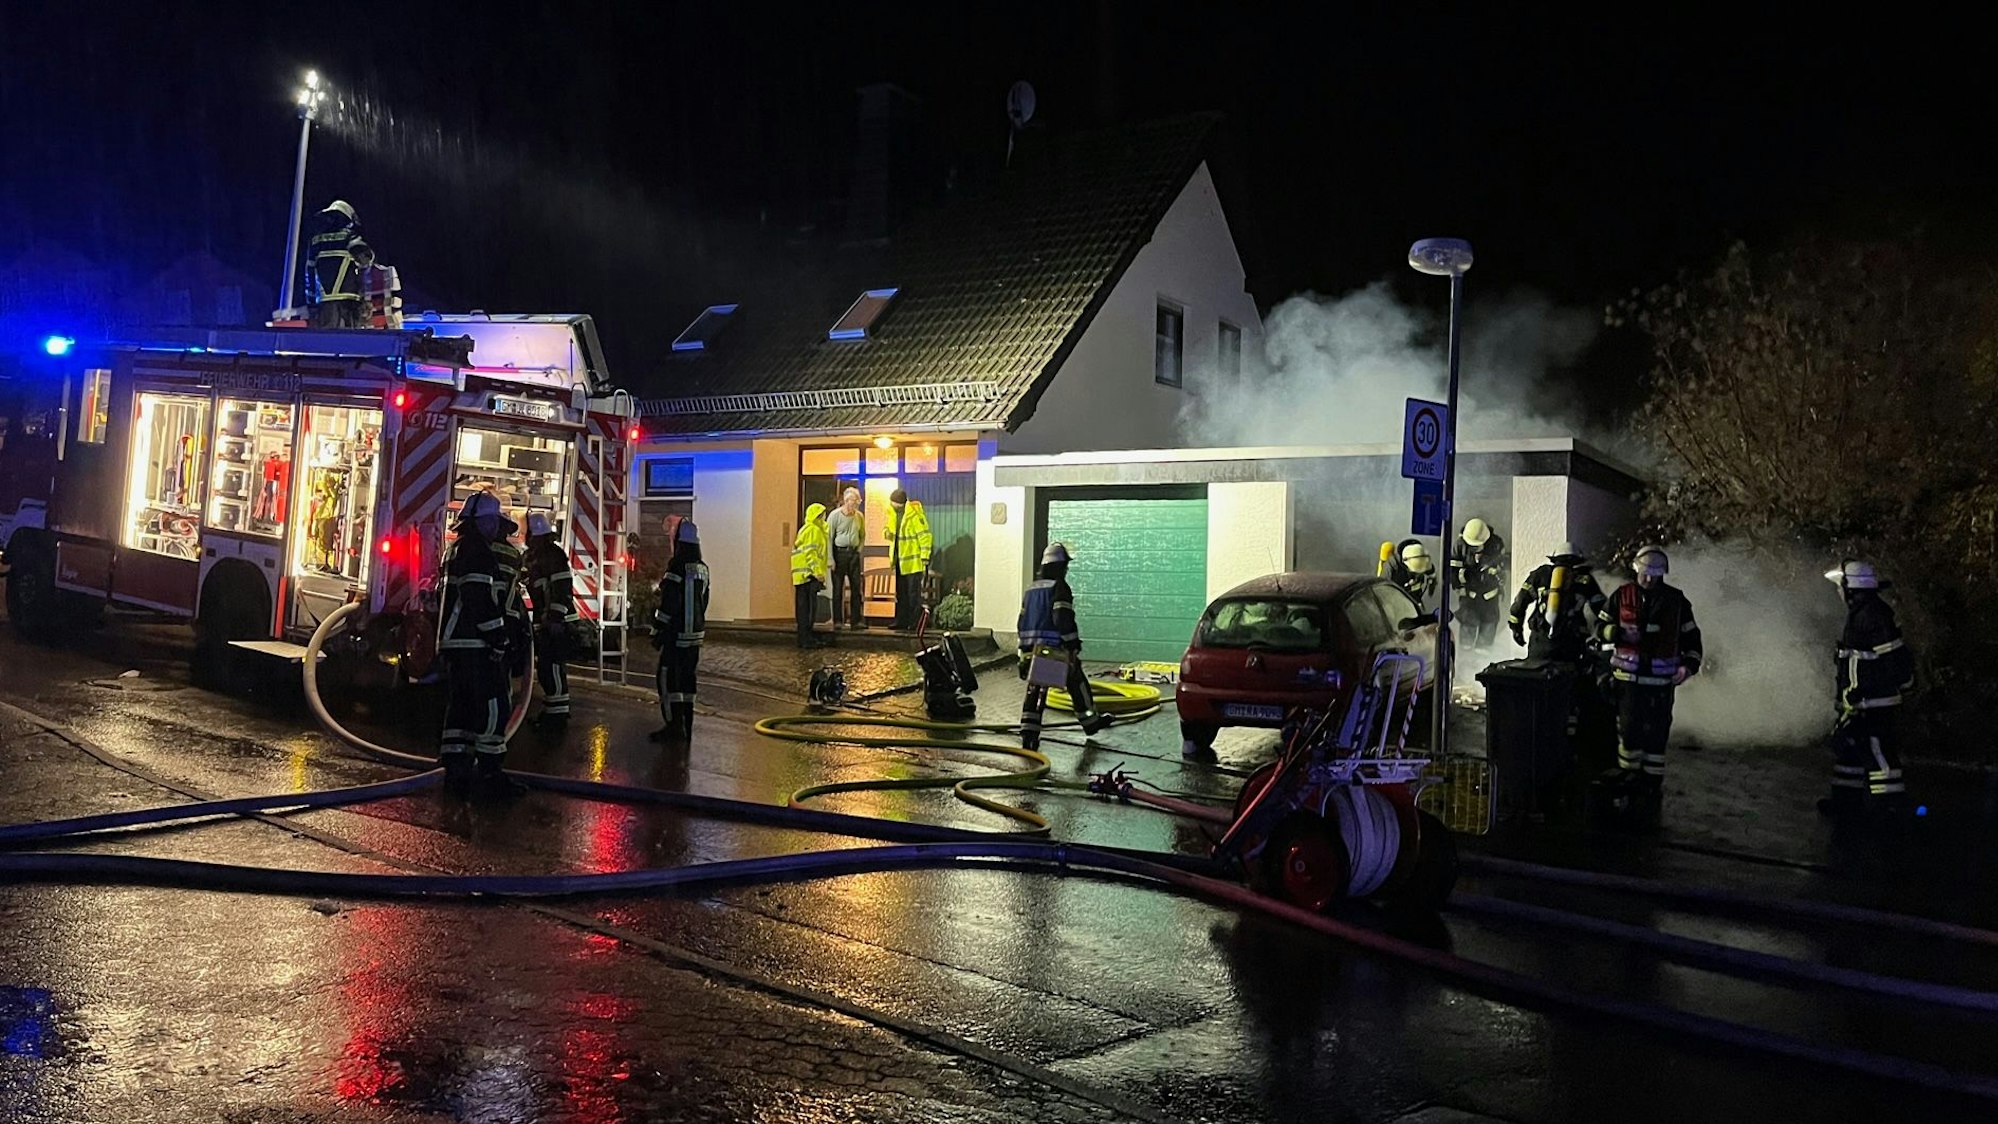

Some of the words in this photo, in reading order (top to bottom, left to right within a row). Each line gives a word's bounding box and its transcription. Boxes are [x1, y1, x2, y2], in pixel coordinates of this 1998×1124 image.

[201, 371, 270, 389] FEUERWEHR
[283, 373, 302, 391] 112
[425, 412, 448, 431] 112
[1418, 421, 1434, 445] 30
[1413, 461, 1435, 475] ZONE
